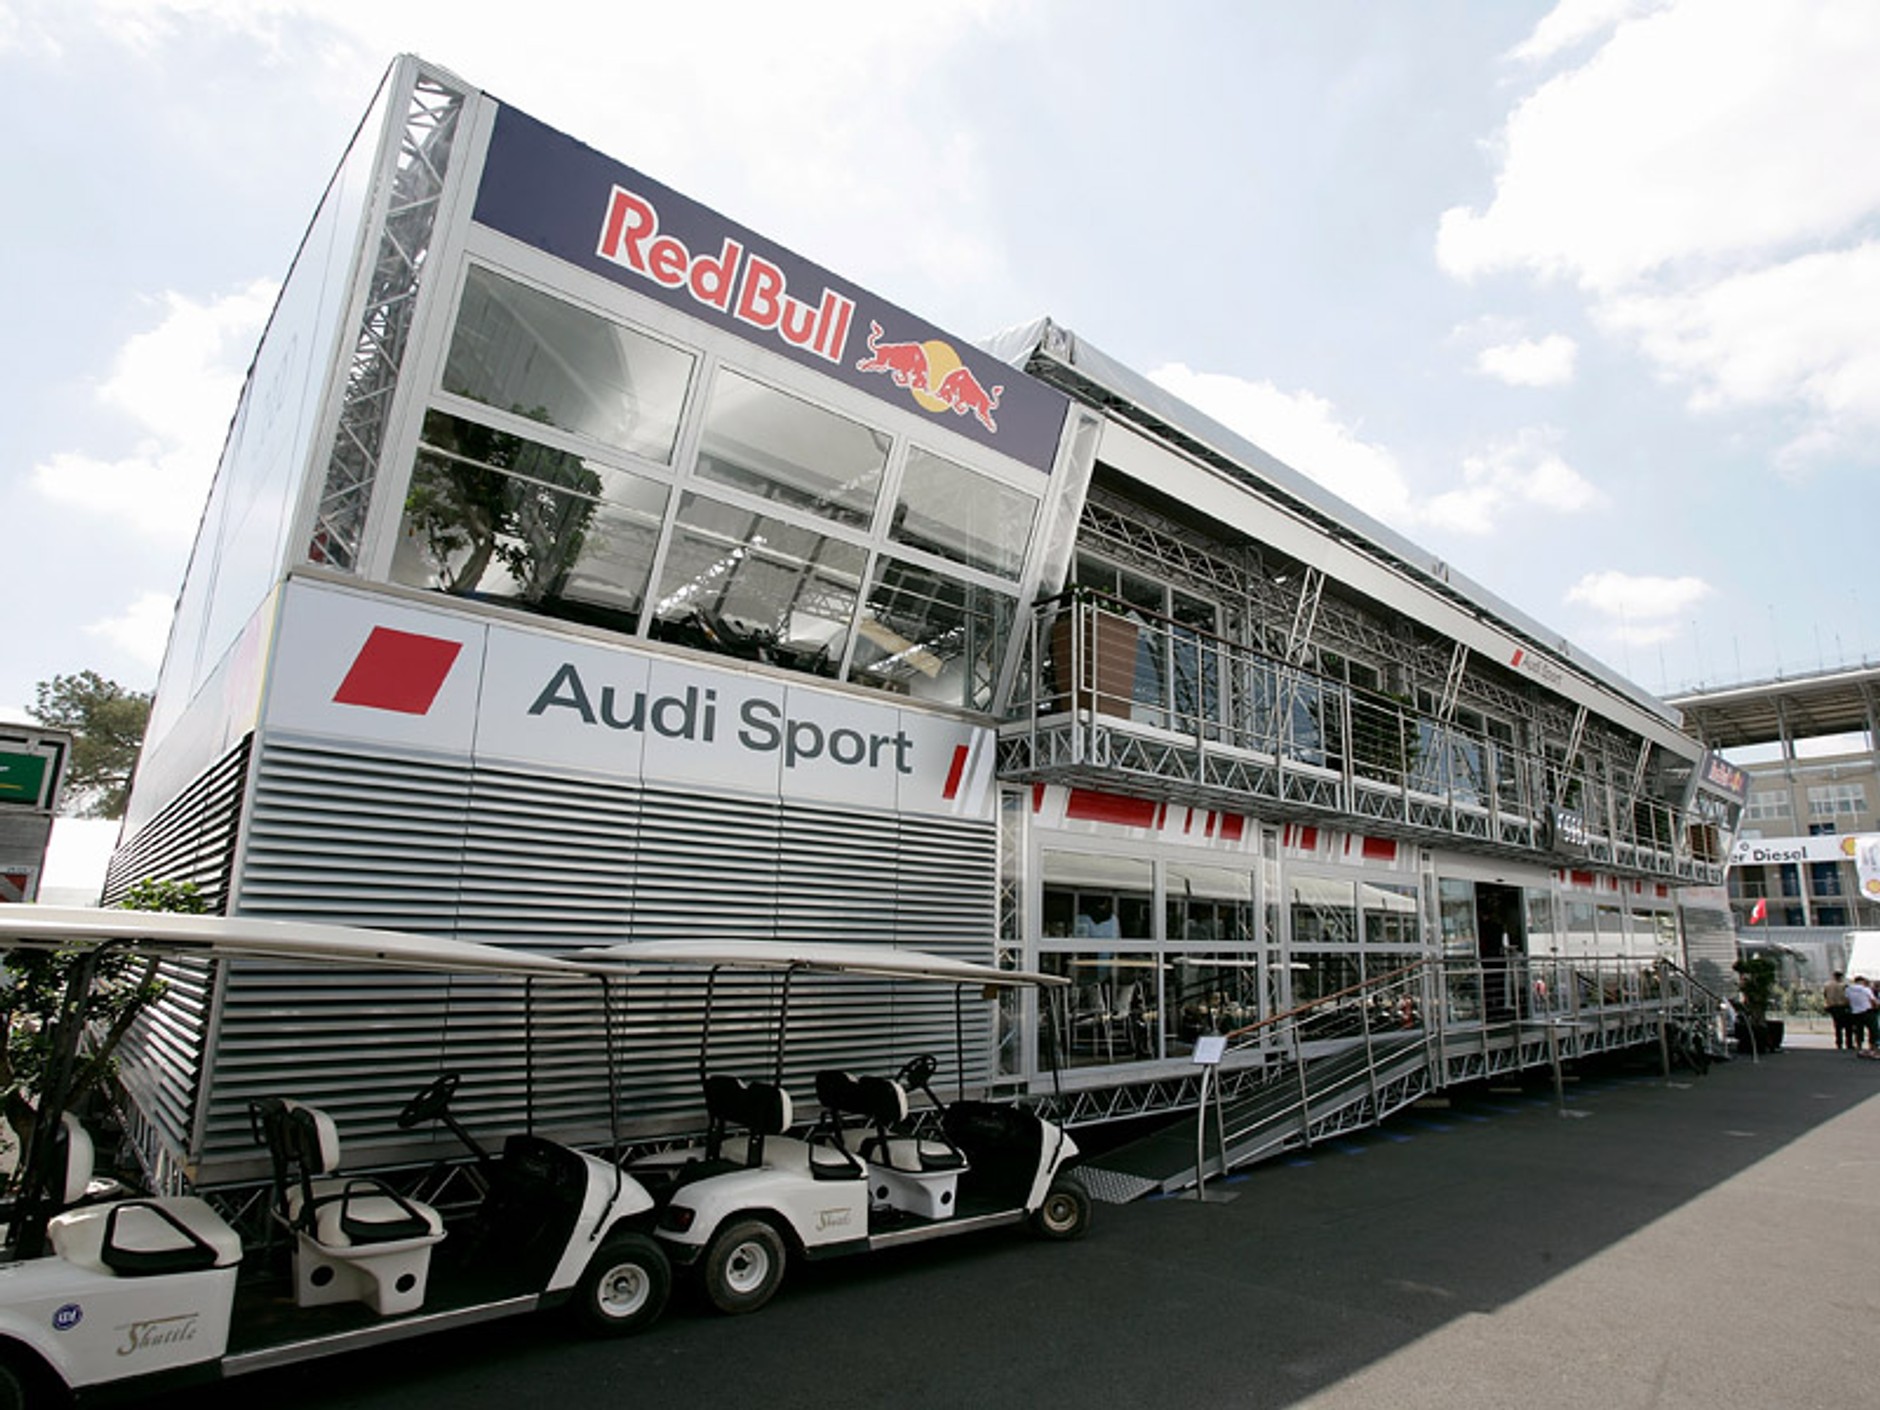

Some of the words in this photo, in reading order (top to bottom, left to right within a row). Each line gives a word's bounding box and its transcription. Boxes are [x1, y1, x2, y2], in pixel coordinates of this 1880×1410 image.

[597, 184, 743, 315] Red
[734, 253, 856, 364] Bull
[527, 662, 716, 742] Audi
[738, 698, 914, 774] Sport
[1753, 846, 1808, 862] Diesel
[114, 1312, 199, 1356] Shuttle
